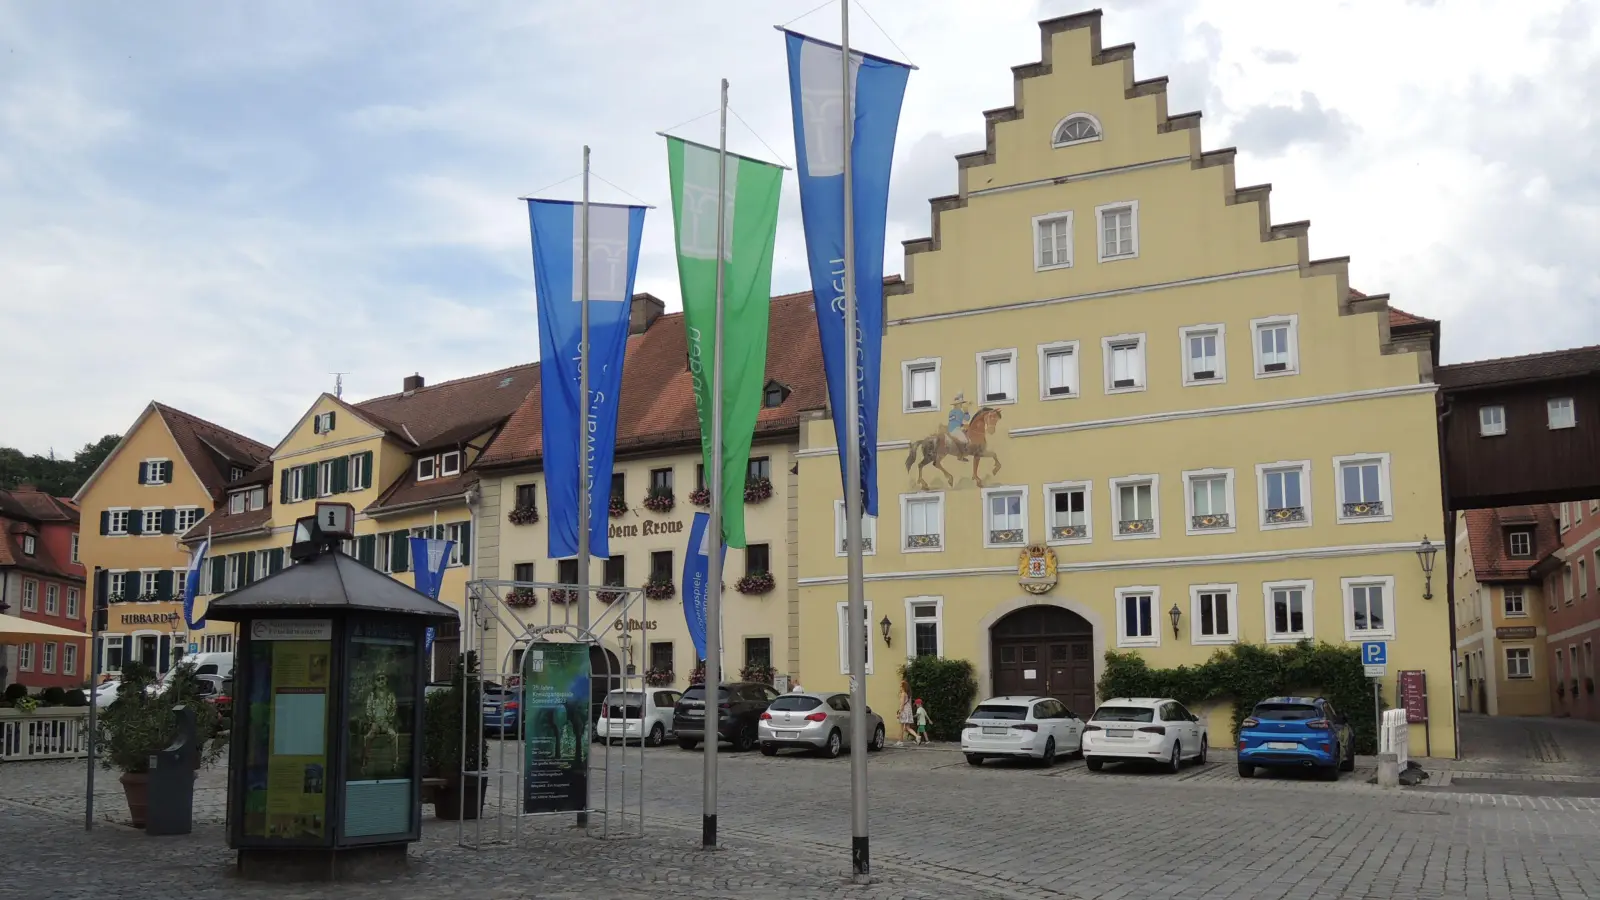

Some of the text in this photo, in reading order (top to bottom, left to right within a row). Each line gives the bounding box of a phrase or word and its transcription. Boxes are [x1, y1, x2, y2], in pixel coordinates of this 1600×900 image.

[607, 519, 684, 538] dene Krone
[1368, 645, 1381, 662] P
